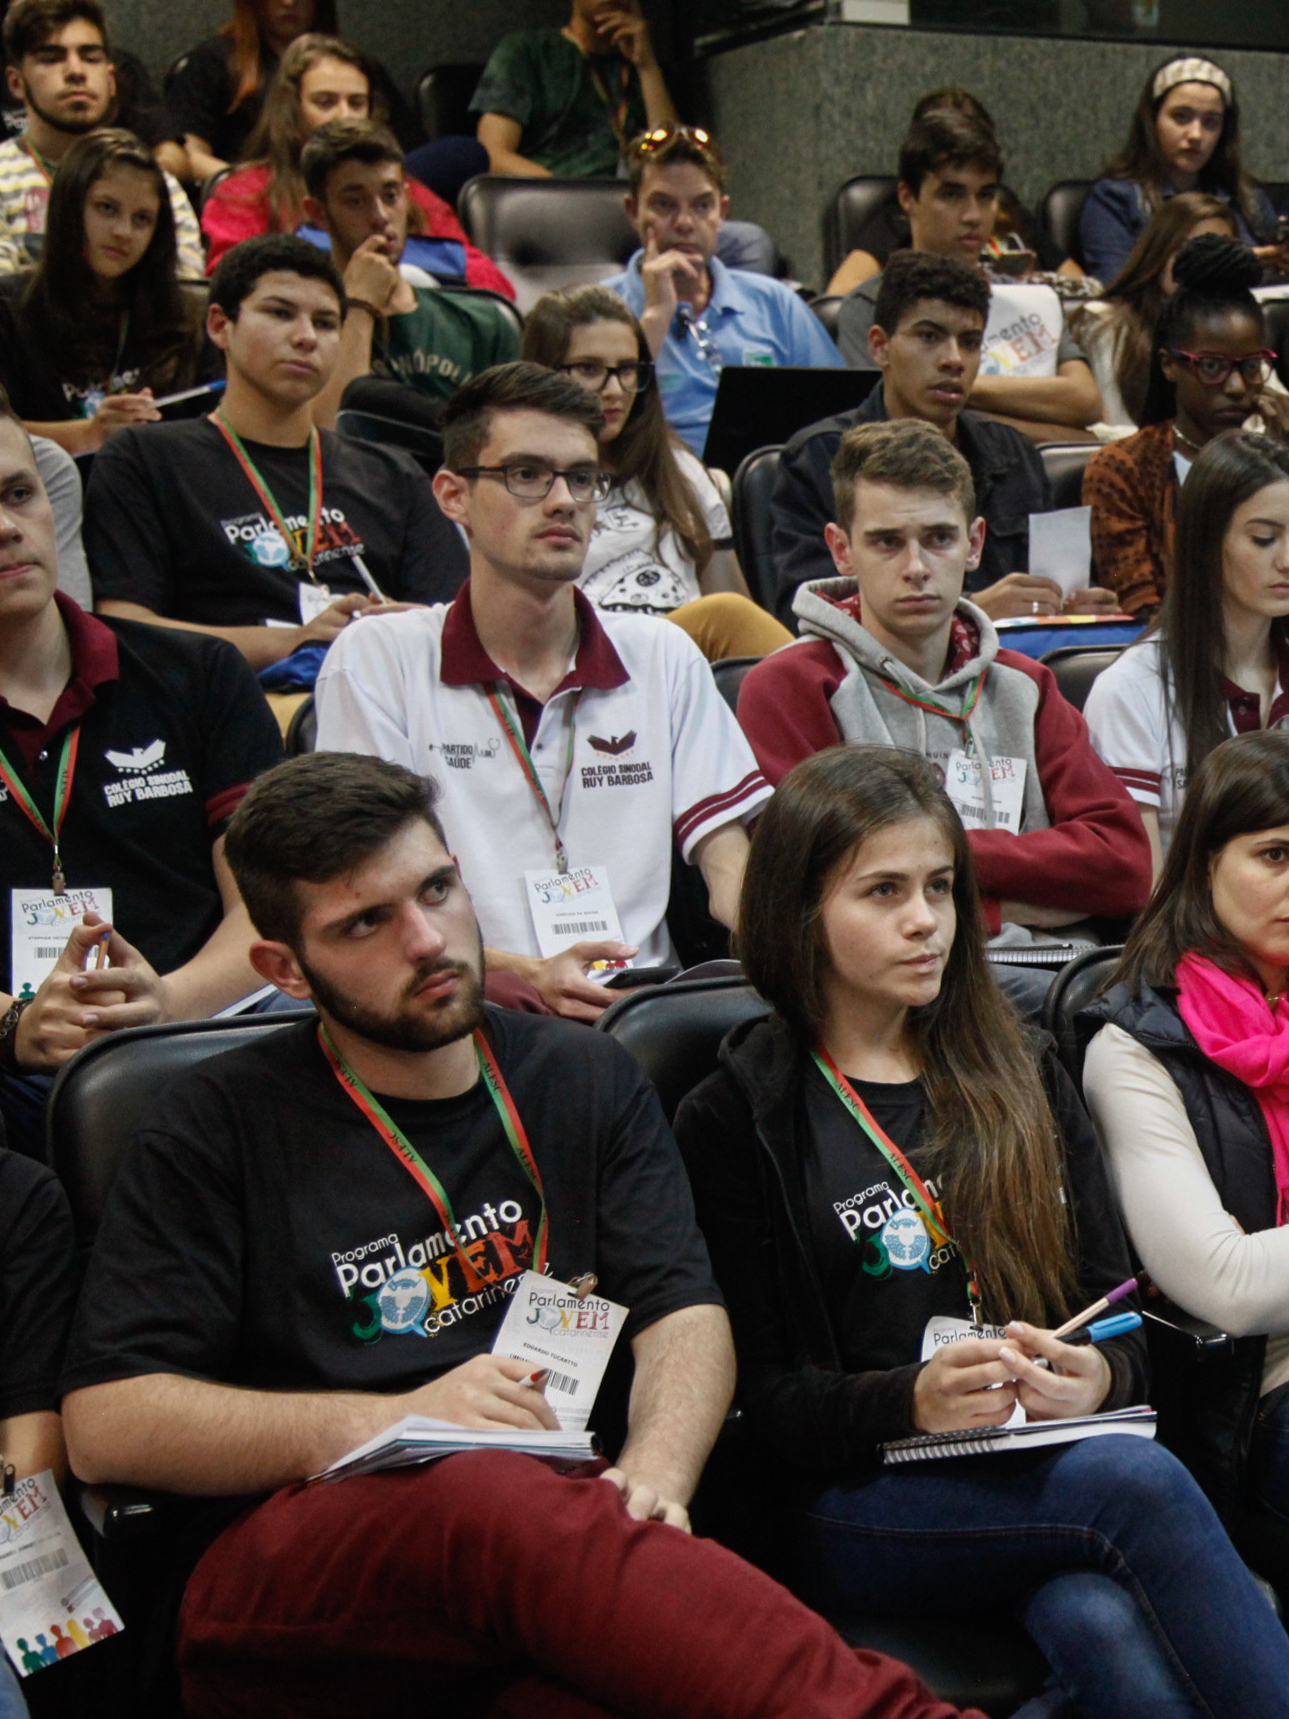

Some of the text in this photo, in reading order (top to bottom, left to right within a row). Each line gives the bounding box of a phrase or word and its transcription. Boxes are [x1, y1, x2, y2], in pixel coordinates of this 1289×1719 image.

[442, 743, 474, 755] PARTIDO
[581, 761, 652, 777] COLÉGIO SINODAL
[956, 758, 1012, 771] Parlaento
[104, 769, 190, 796] COLÉGIO SINODAL
[582, 771, 654, 789] RUY BARBOSA
[107, 780, 193, 808] RUY BARBOSA
[534, 868, 592, 892] Parlamento
[21, 890, 93, 914] Parlamento
[833, 1181, 890, 1215] Programa
[839, 1174, 943, 1241] Parlam
[331, 1233, 399, 1266] Programa
[336, 1200, 522, 1298] Parlamento
[529, 1292, 610, 1312] Parlamento
[523, 1342, 549, 1356] EDUARDO
[0, 1478, 35, 1515] mento
